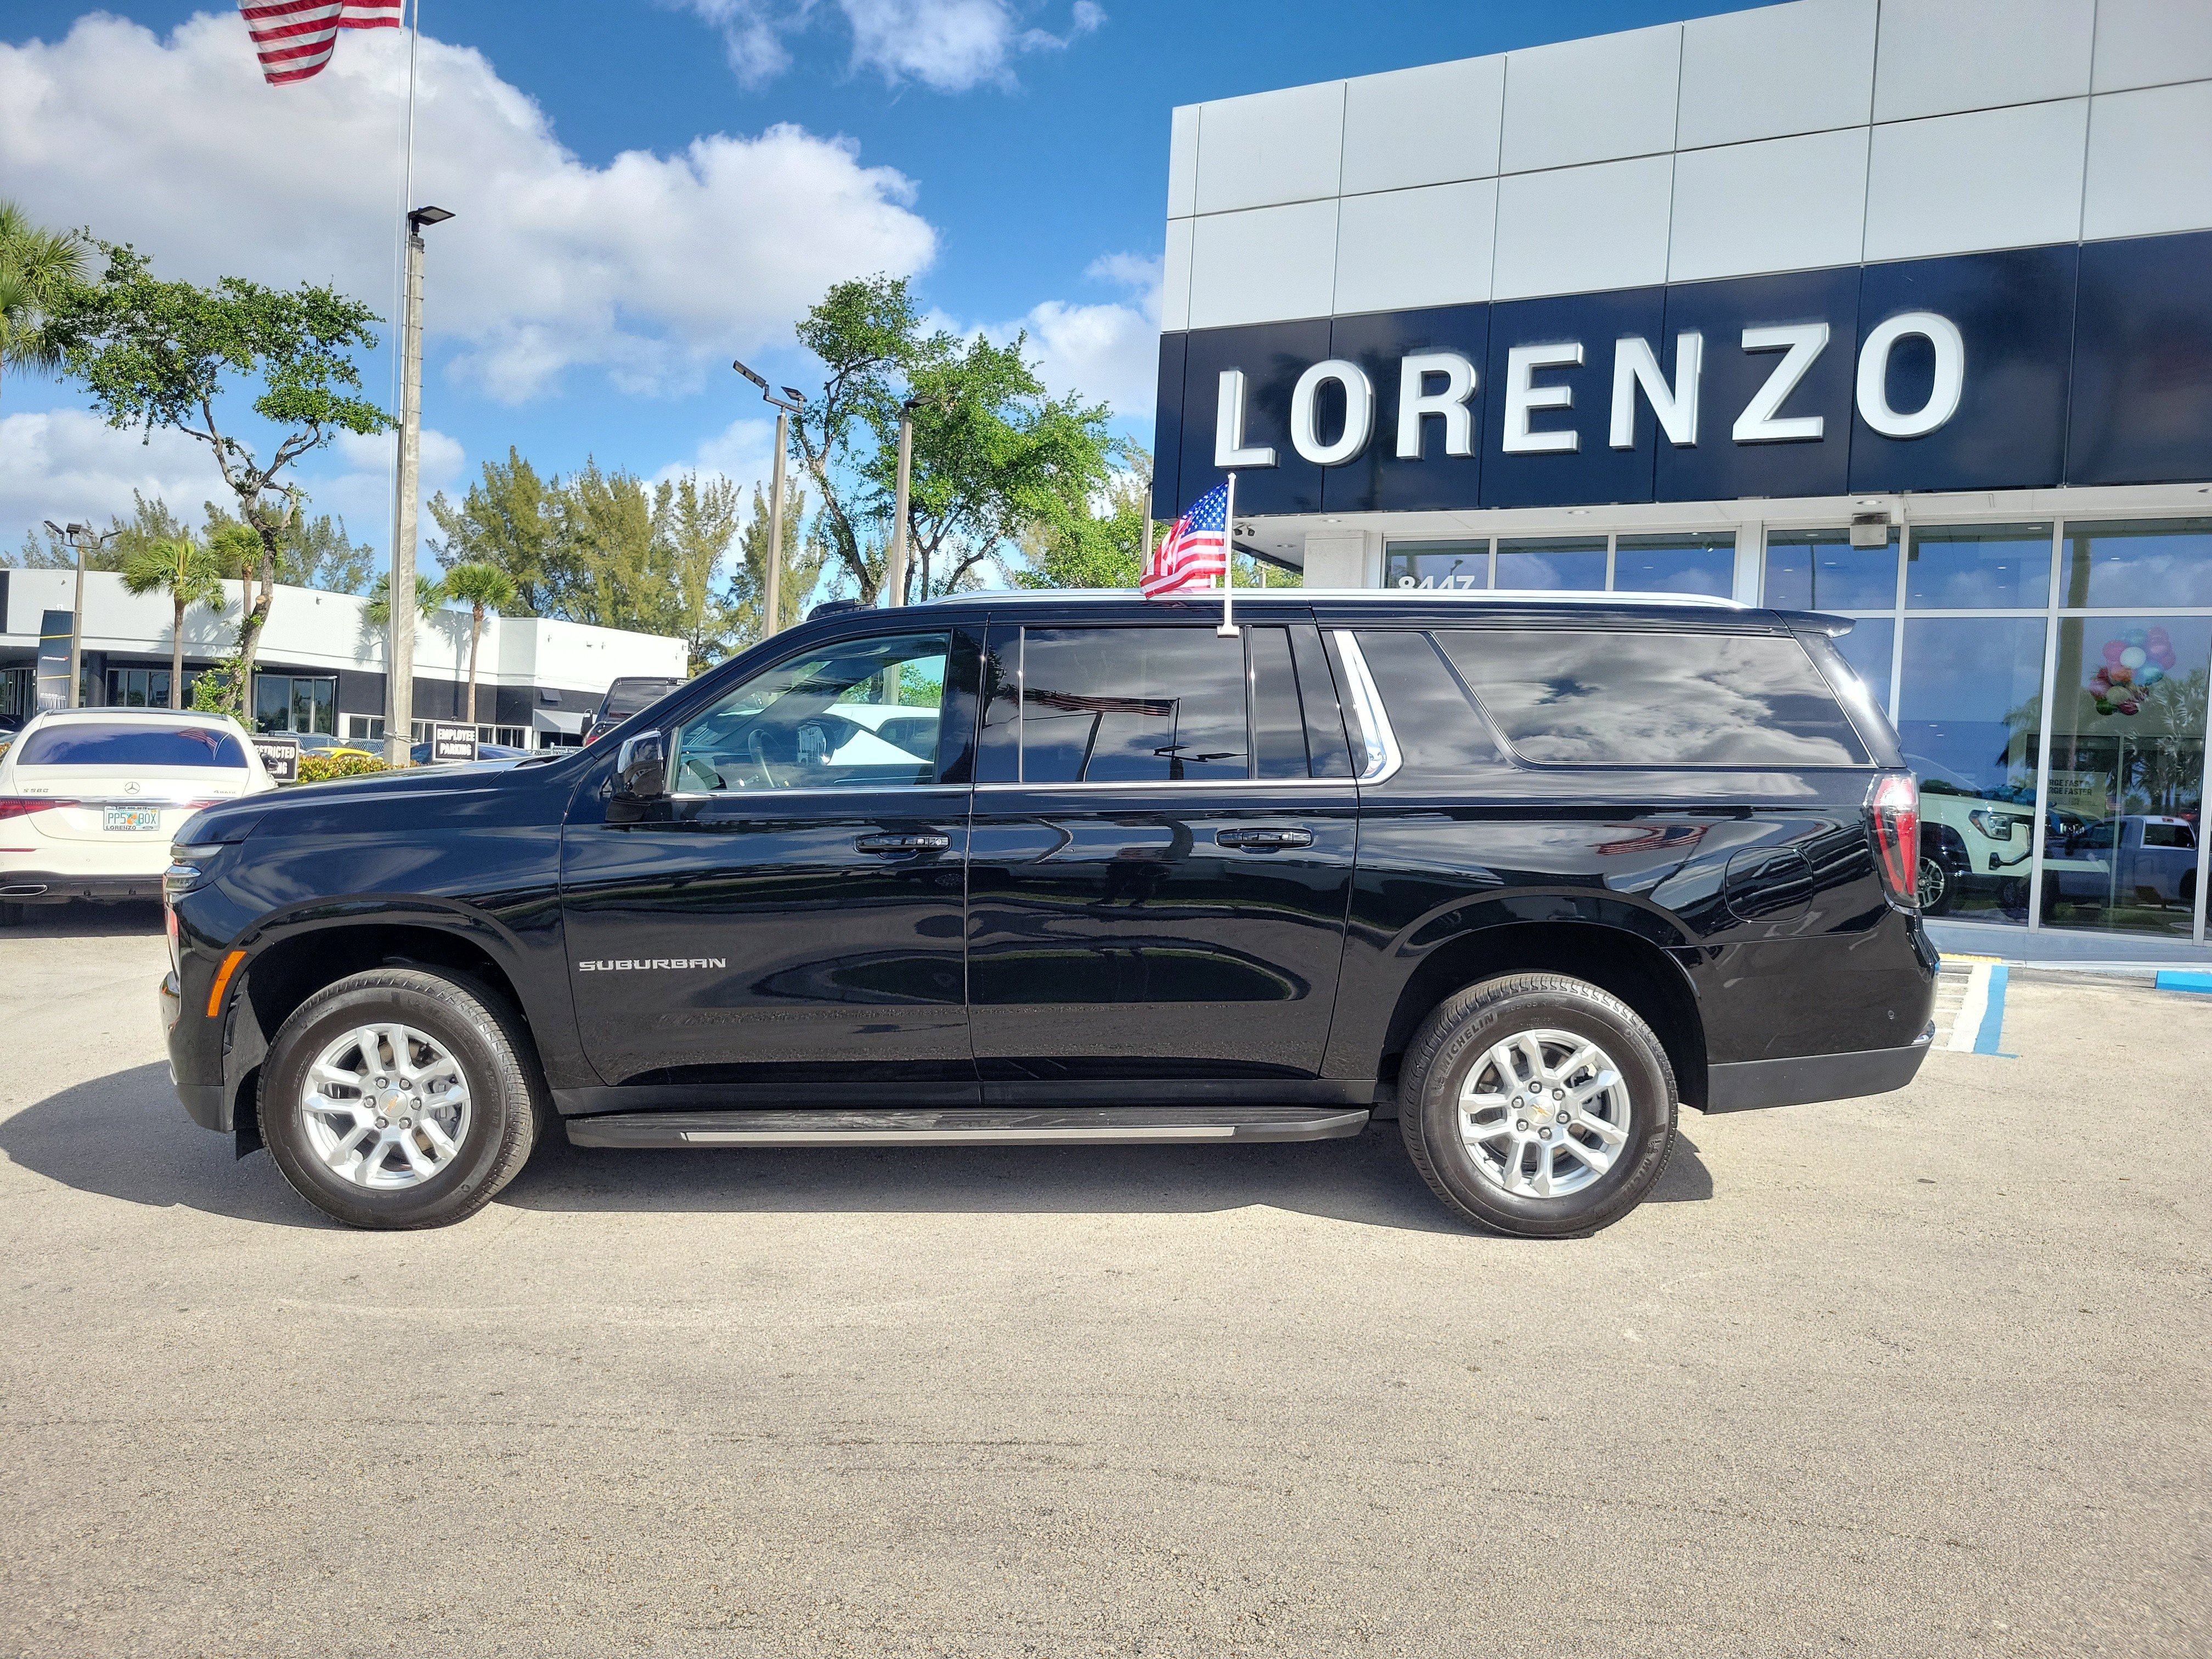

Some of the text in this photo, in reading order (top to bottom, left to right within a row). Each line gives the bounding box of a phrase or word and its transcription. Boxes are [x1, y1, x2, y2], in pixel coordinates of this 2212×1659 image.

[1214, 312, 1964, 468] LORENZO
[437, 728, 475, 742] EMPLOYEE
[255, 744, 295, 759] ESTRICTED
[440, 743, 472, 755] PARKING
[108, 813, 156, 823] PP5 BOX
[579, 958, 726, 971] SUBURBAN
[1440, 1013, 1494, 1073] MICHELIN
